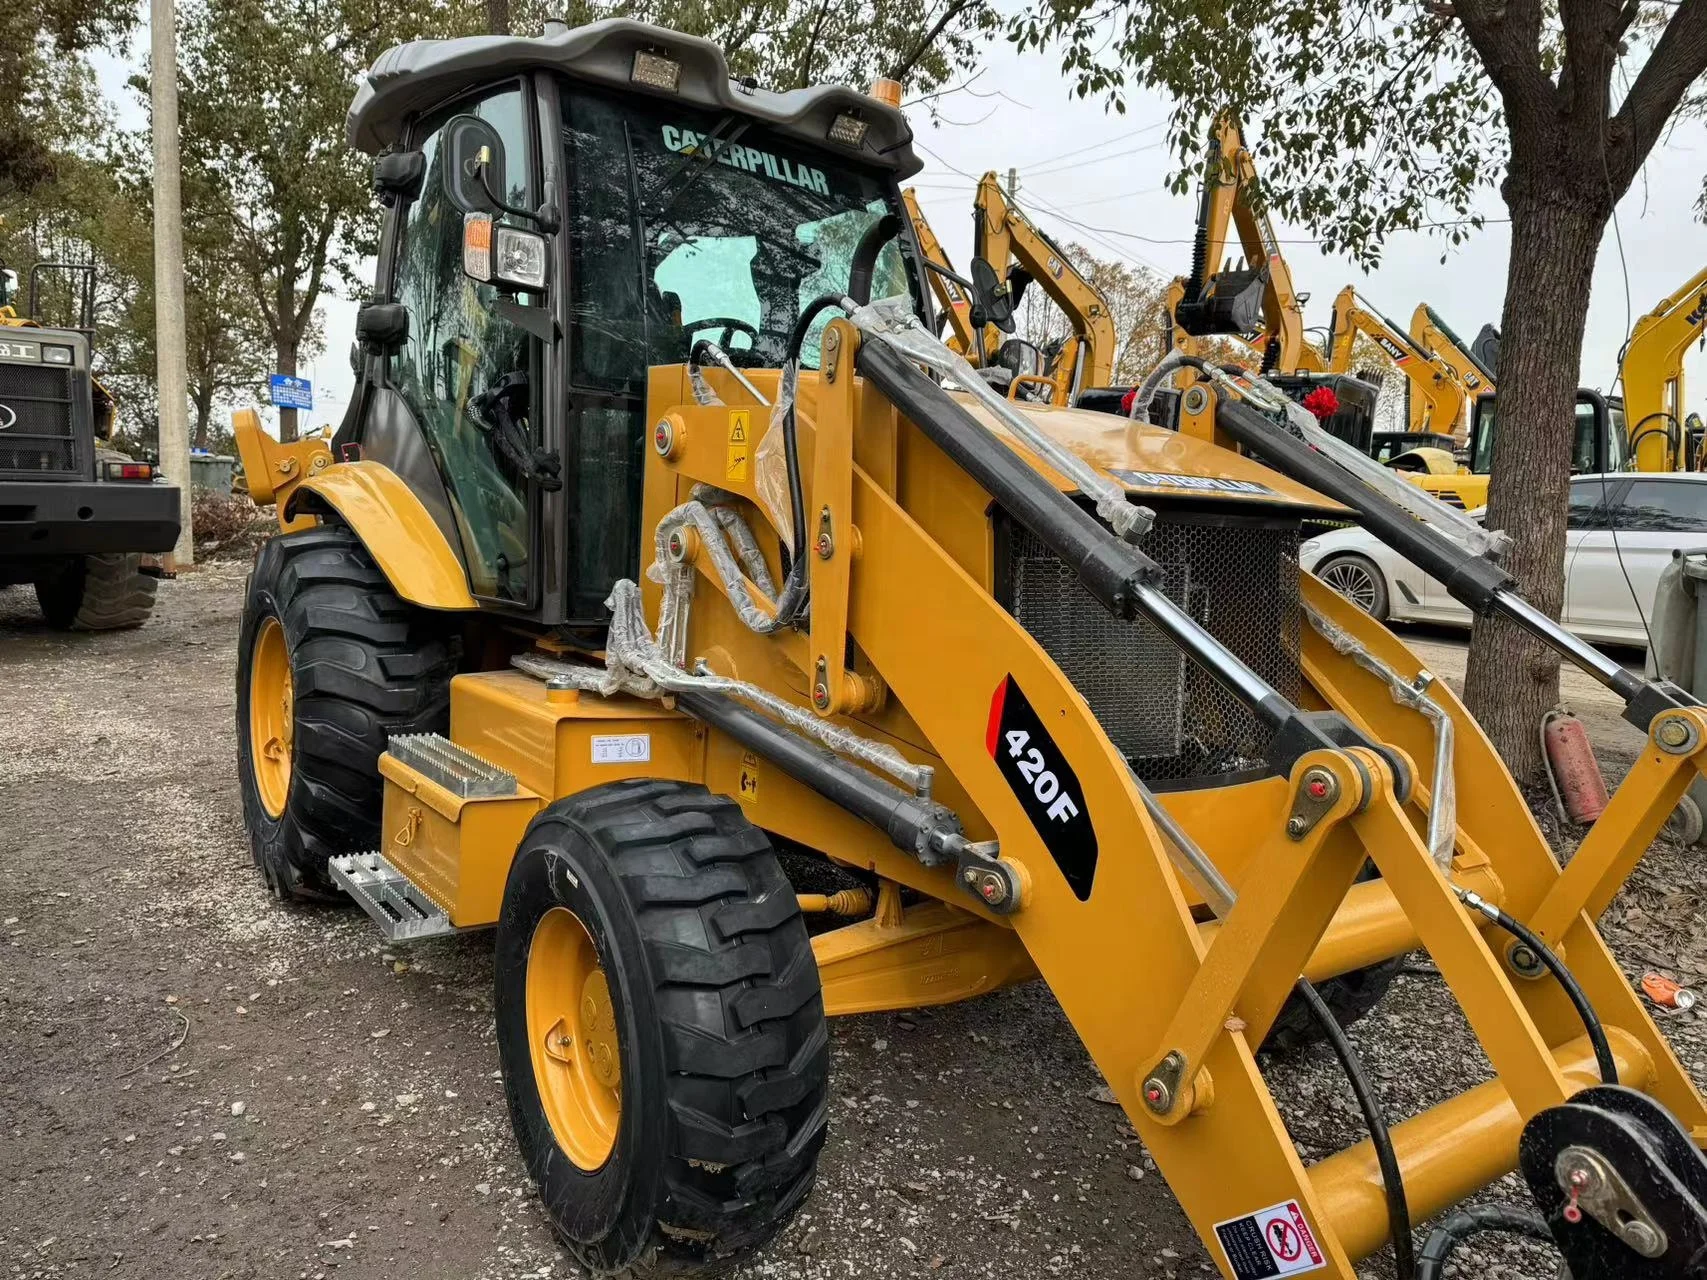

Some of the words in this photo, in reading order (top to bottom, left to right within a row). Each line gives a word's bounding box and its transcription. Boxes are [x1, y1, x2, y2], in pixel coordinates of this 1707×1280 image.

[661, 124, 772, 197] CATERPILLAR
[1005, 730, 1080, 824] 420F
[1237, 1221, 1251, 1241] KEEP
[1246, 1241, 1262, 1266] CLEAR
[1244, 1219, 1264, 1250] CRUSH
[1258, 1249, 1274, 1271] RISK
[1296, 1222, 1318, 1257] DANGER
